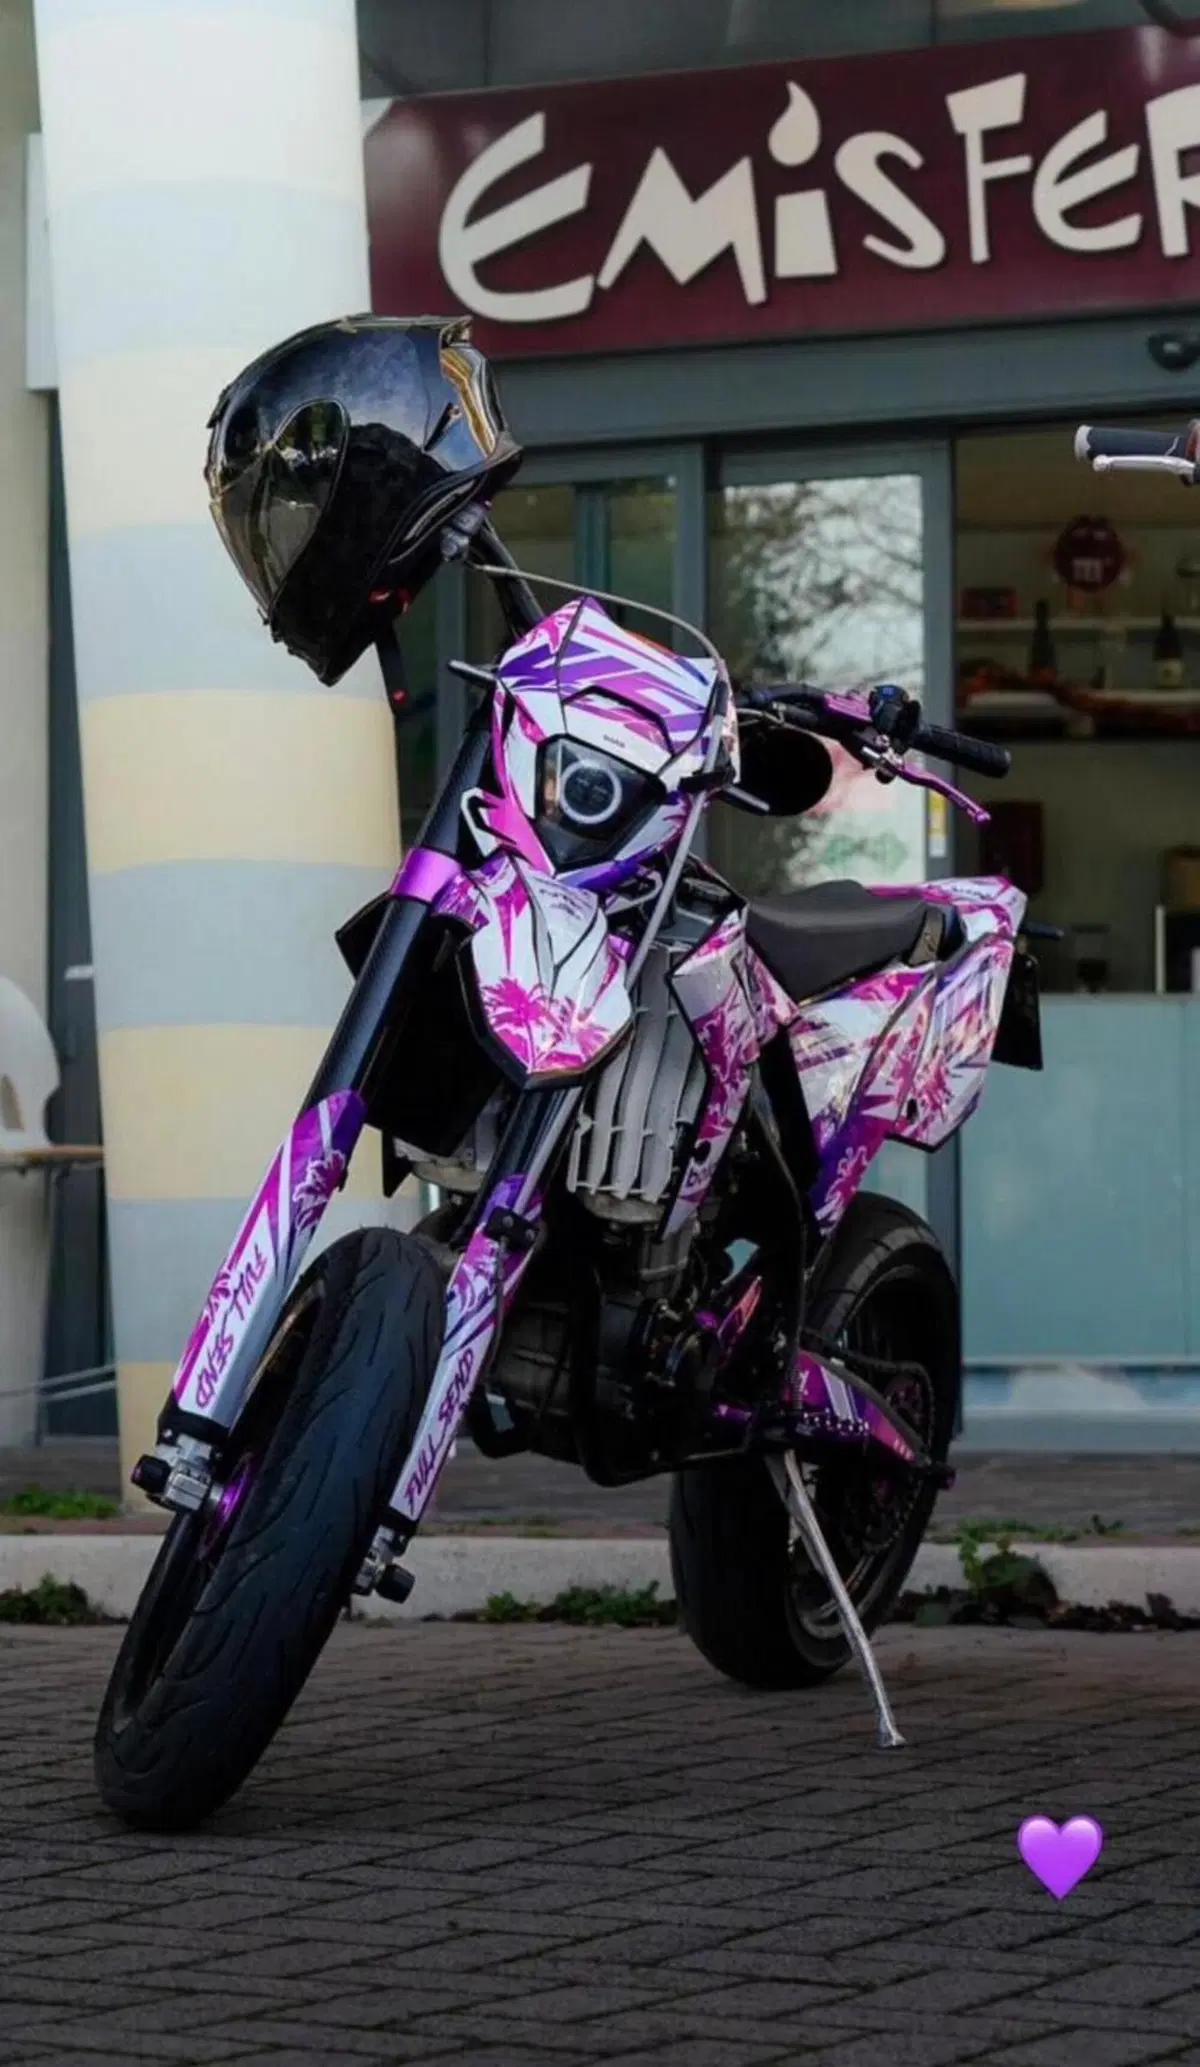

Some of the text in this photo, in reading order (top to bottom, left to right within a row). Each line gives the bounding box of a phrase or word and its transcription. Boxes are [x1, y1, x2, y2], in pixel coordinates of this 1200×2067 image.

[196, 1243, 268, 1408] FULL SEND
[404, 1347, 474, 1517] FULL SEND
